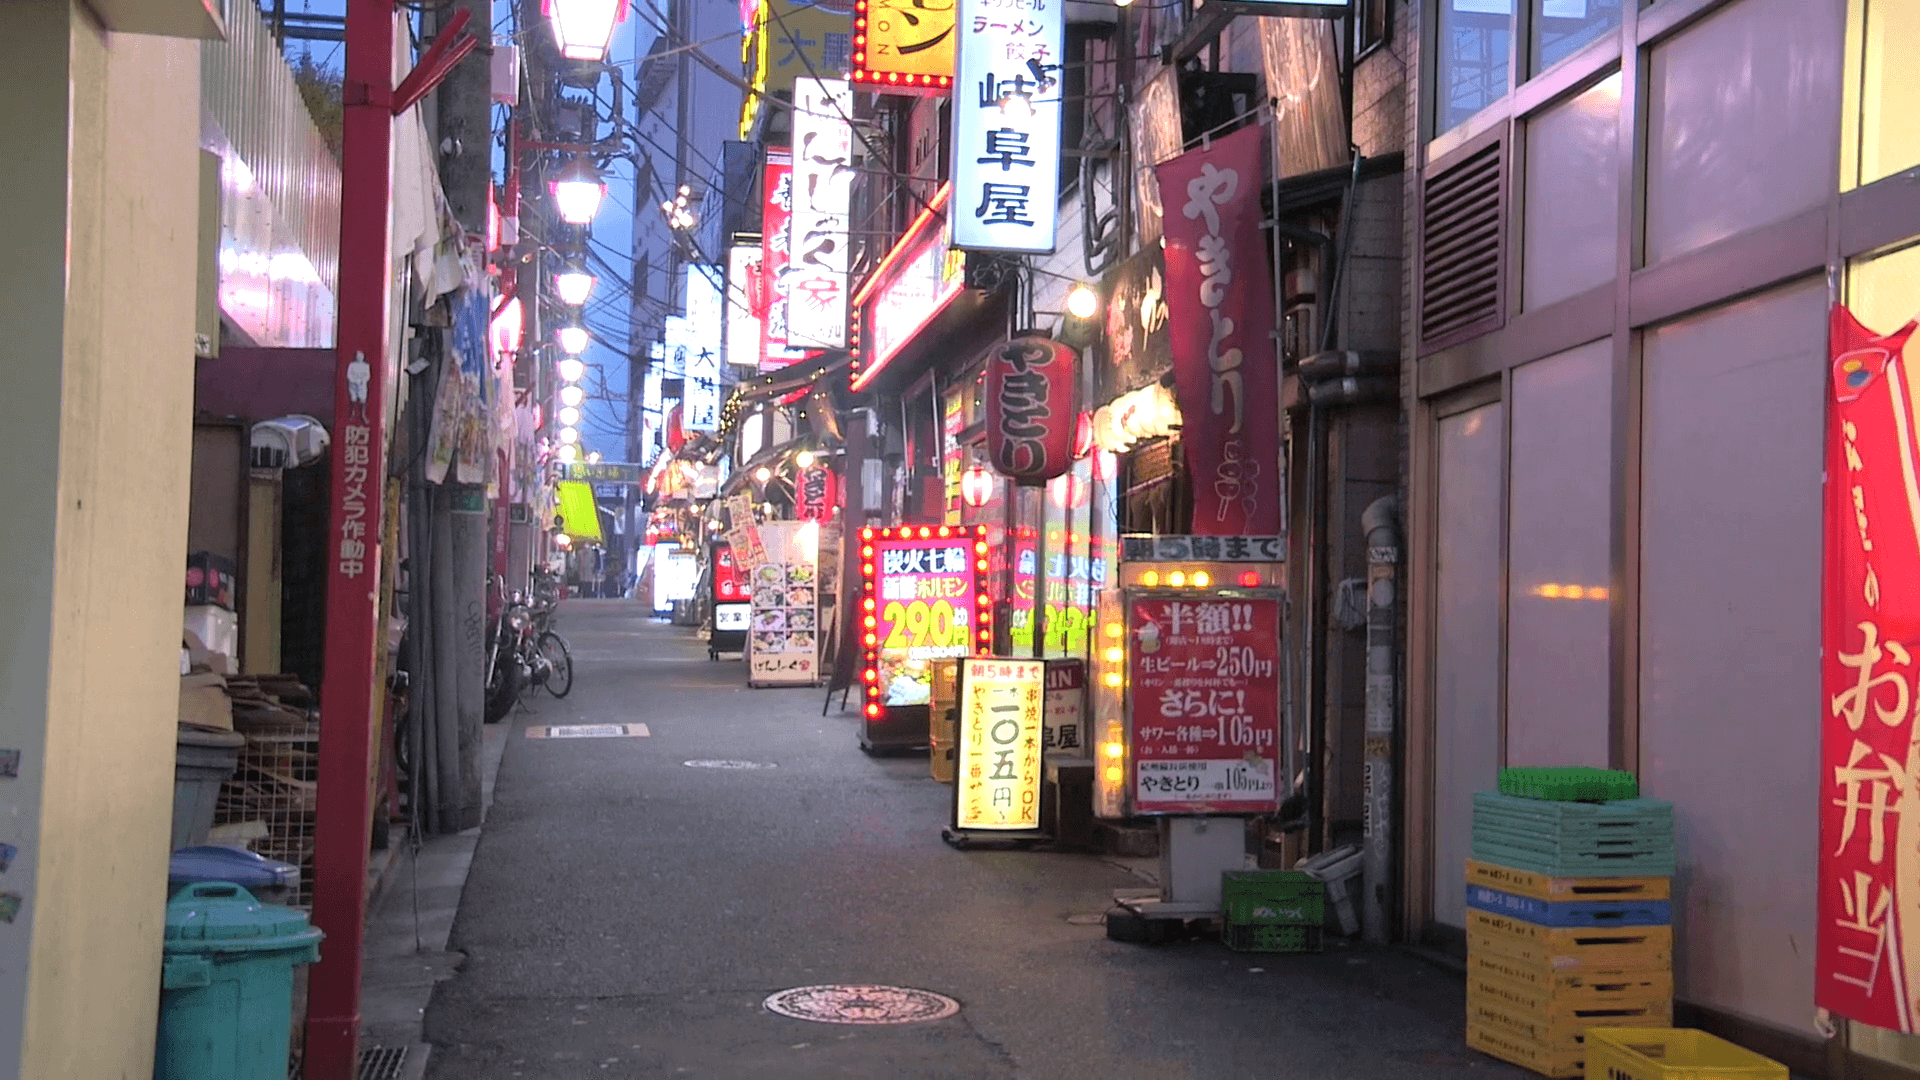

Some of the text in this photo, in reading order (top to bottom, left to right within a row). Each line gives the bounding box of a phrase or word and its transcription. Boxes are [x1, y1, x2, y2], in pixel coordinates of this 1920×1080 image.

[972, 16, 1044, 37] ラーメン
[1005, 42, 1051, 61] 餃子
[976, 72, 1036, 228] 岐阜屋
[1182, 162, 1246, 435] やきとり
[999, 343, 1056, 475] やきとり
[339, 425, 371, 580] 防犯カメラ作動中
[883, 547, 966, 575] 炭火七輪
[1160, 602, 1253, 635] 半額!!
[970, 664, 1040, 680] 朝5時まで
[1159, 688, 1246, 718] さらに!
[1140, 775, 1200, 792] やきとり
[1831, 620, 1913, 999] お弁当
